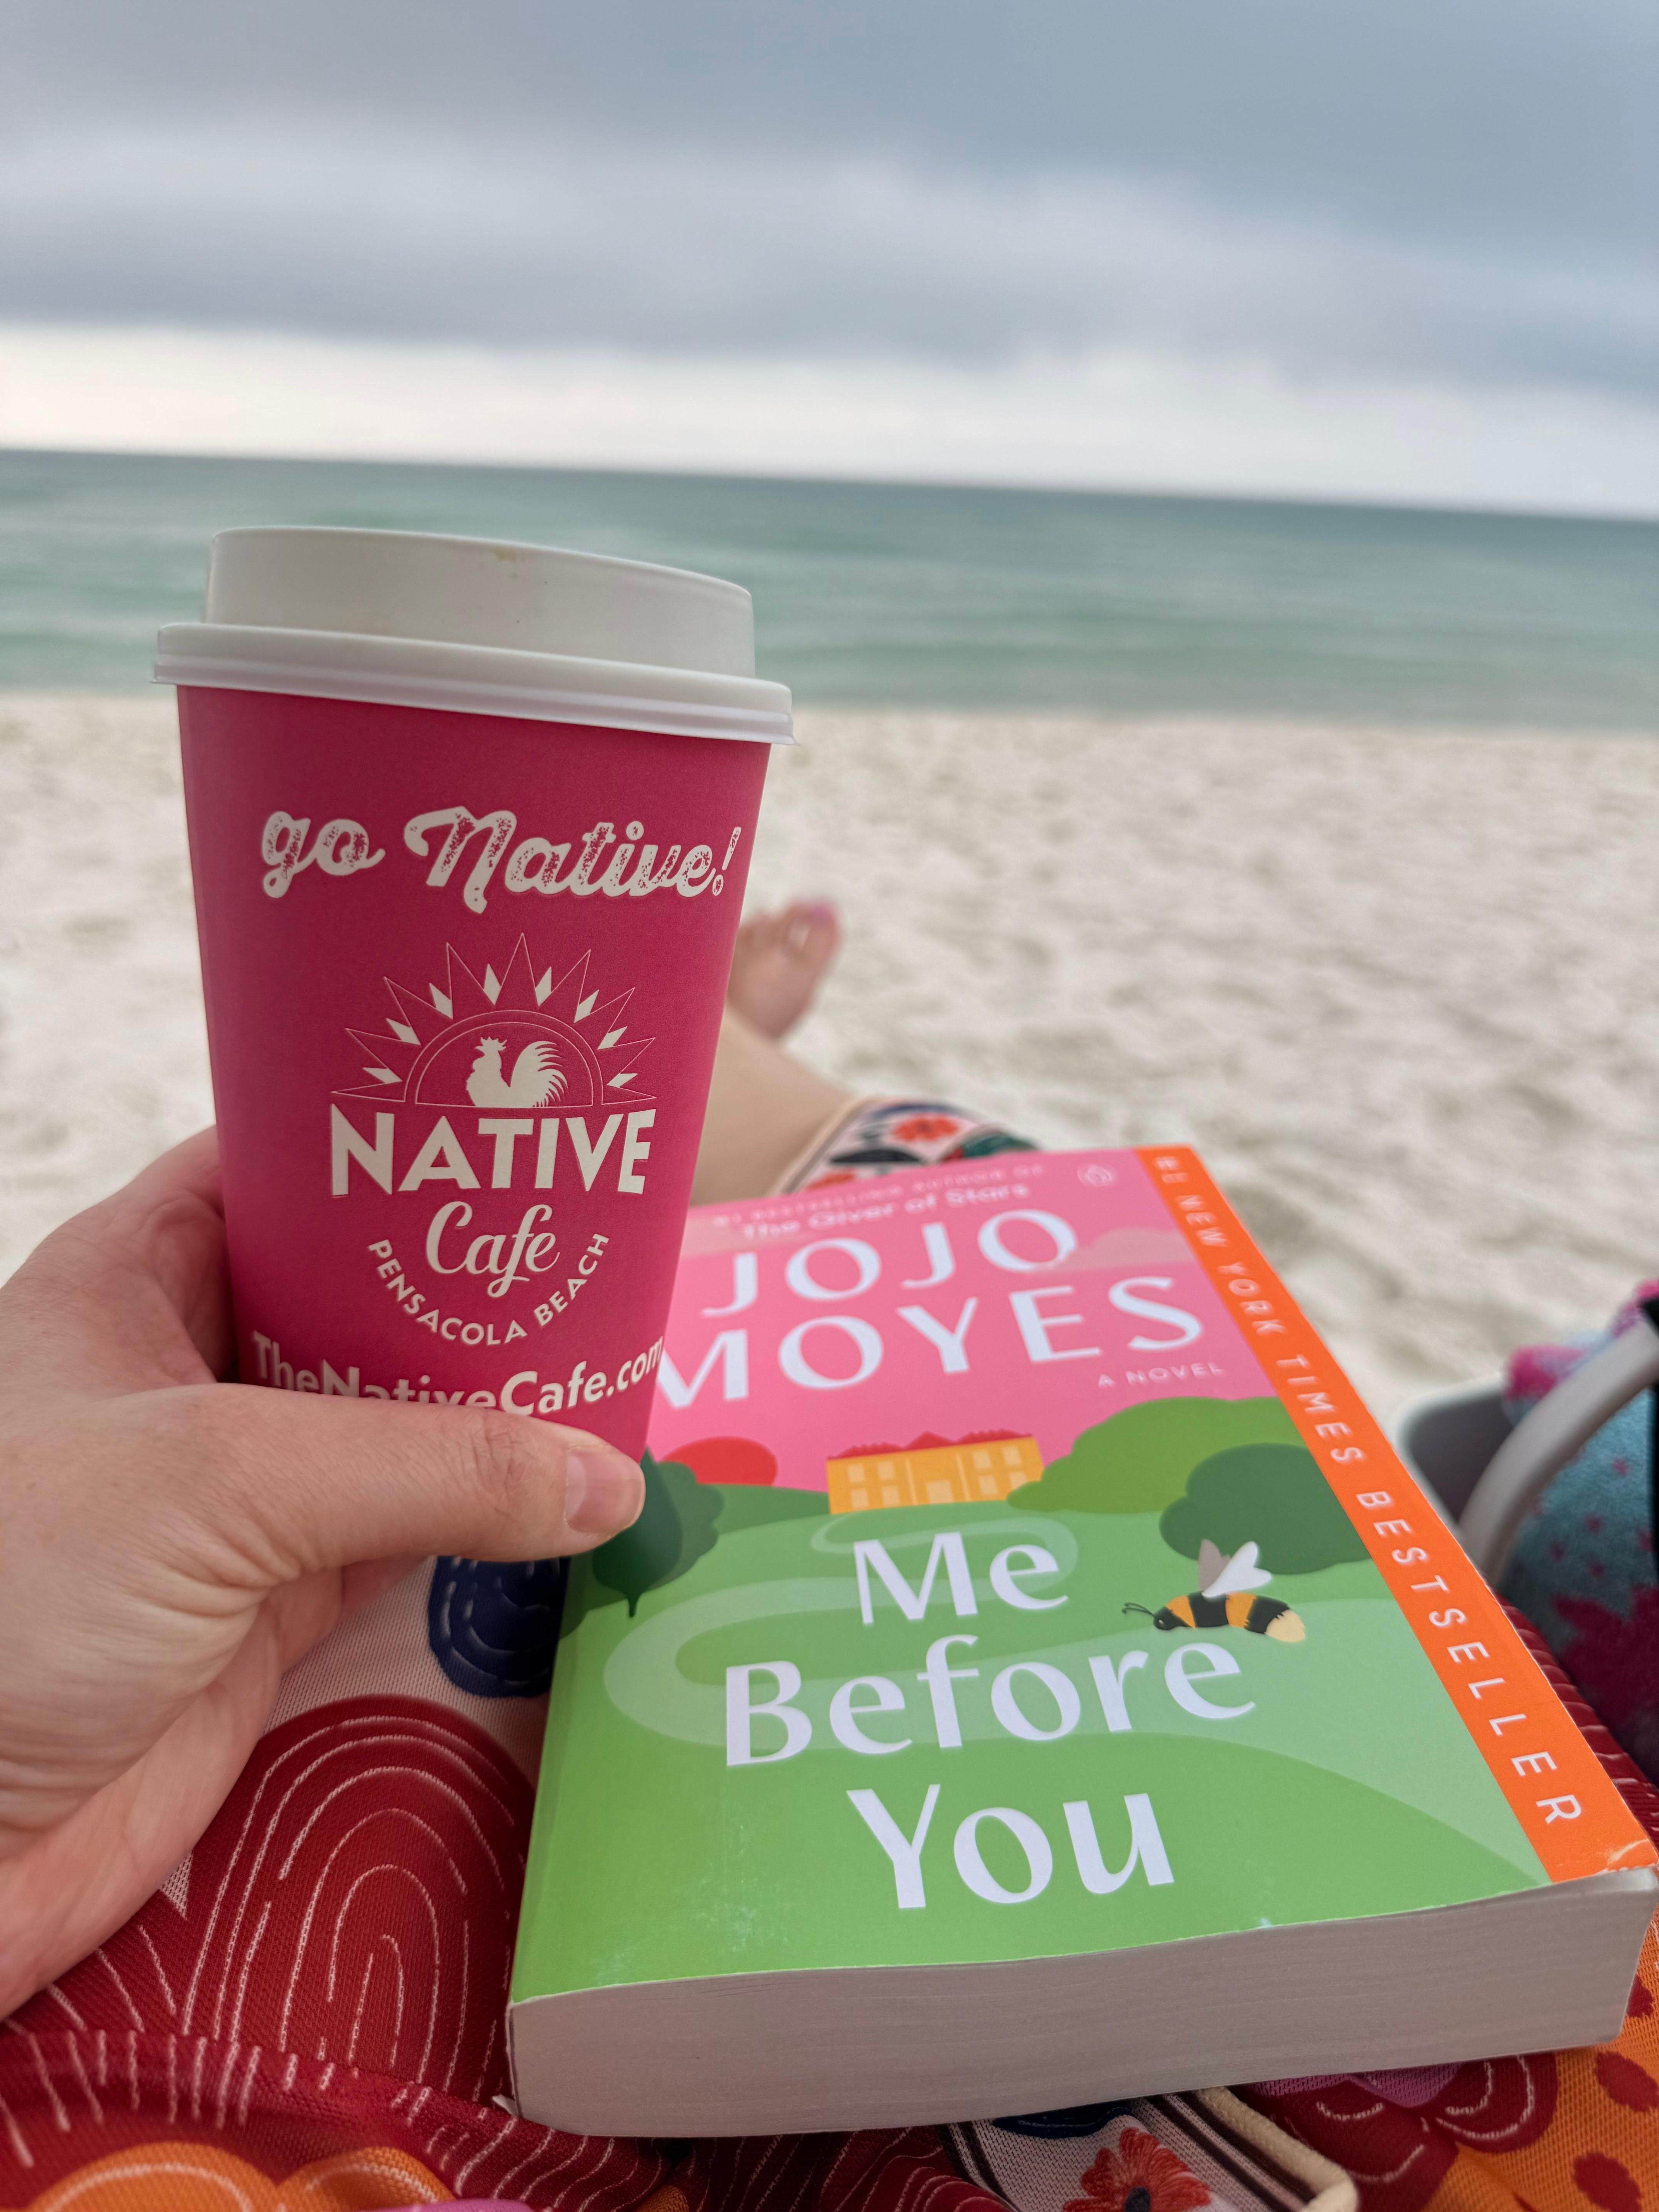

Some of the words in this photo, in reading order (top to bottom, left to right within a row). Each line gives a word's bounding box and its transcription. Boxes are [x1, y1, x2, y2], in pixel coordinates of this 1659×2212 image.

[262, 811, 386, 898] go
[404, 806, 742, 914] Native!
[331, 1103, 657, 1197] NATIVE
[426, 1201, 560, 1298] Cafe
[702, 1208, 1079, 1318] JOJO
[743, 1219, 801, 1241] The
[808, 1201, 895, 1230] Giver
[904, 1192, 937, 1214] of
[945, 1182, 1031, 1207] Stars
[368, 1239, 528, 1345] PENSACOLA
[534, 1233, 610, 1326] BEACH
[656, 1276, 1204, 1409] MOYES
[1097, 1373, 1116, 1388] A
[1125, 1361, 1225, 1386] NOVEL
[1175, 1194, 1229, 1248] NEW
[1218, 1261, 1287, 1337] YORK
[1276, 1353, 1367, 1464] TIMES
[1356, 1490, 1582, 1824] BESTSELLER
[853, 1531, 1069, 1625] Me
[725, 1634, 1257, 1766] Before
[846, 1783, 1175, 1909] You
